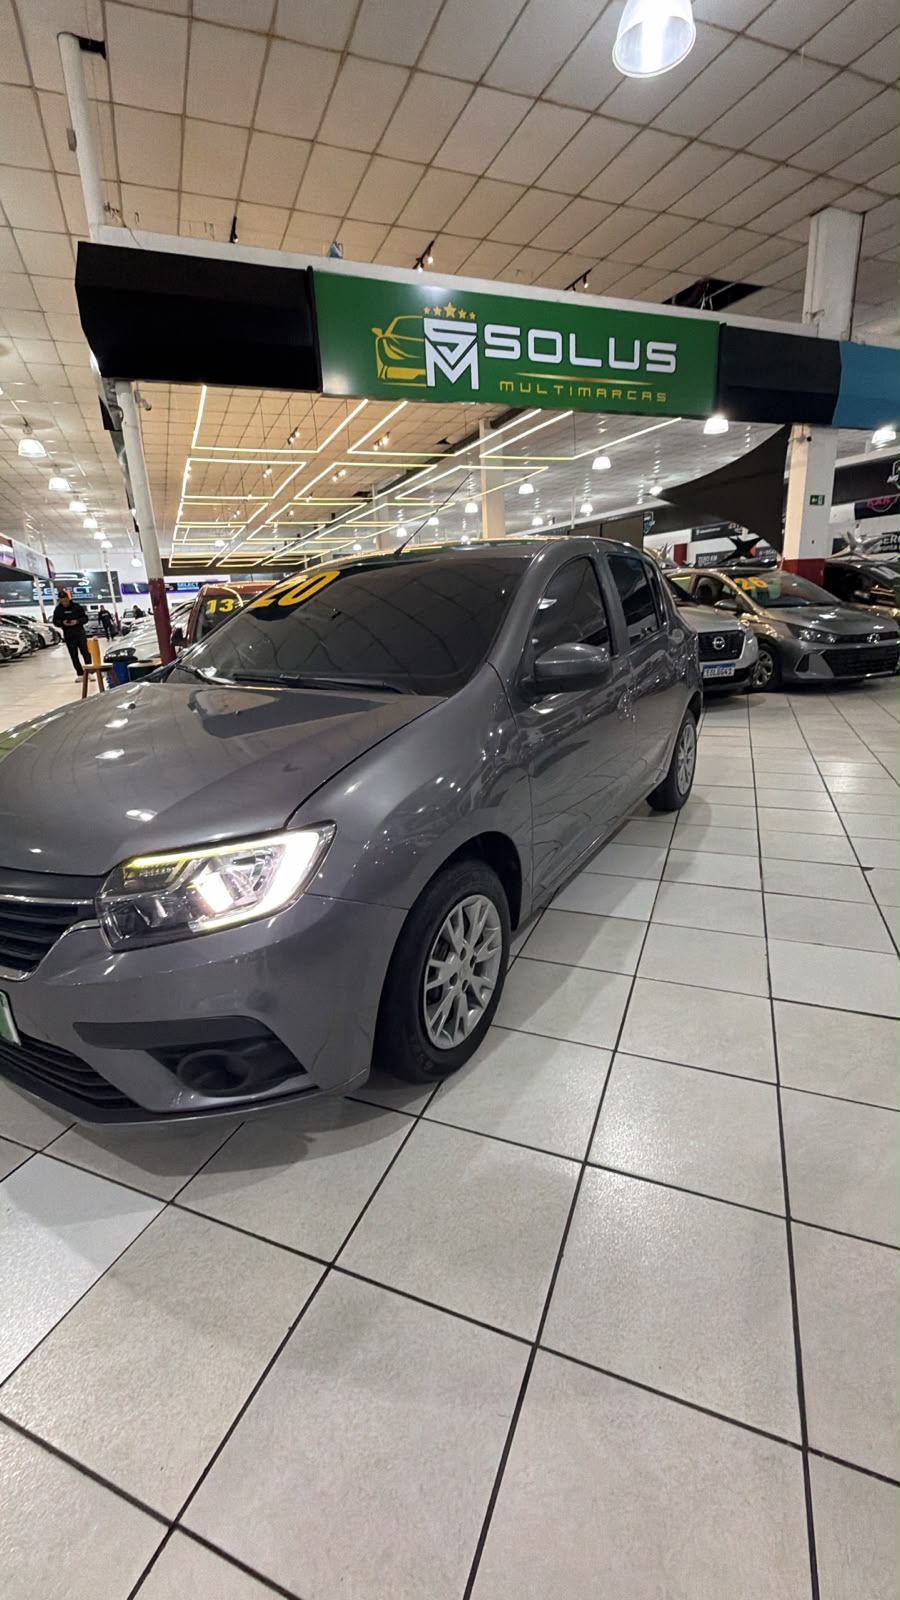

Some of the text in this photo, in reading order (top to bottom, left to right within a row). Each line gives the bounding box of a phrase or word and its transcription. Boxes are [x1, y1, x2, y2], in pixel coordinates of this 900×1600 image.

[484, 323, 677, 374] SOLUS
[499, 380, 667, 402] MULTIMARCAS
[247, 569, 341, 609] 20
[207, 598, 235, 614] 13
